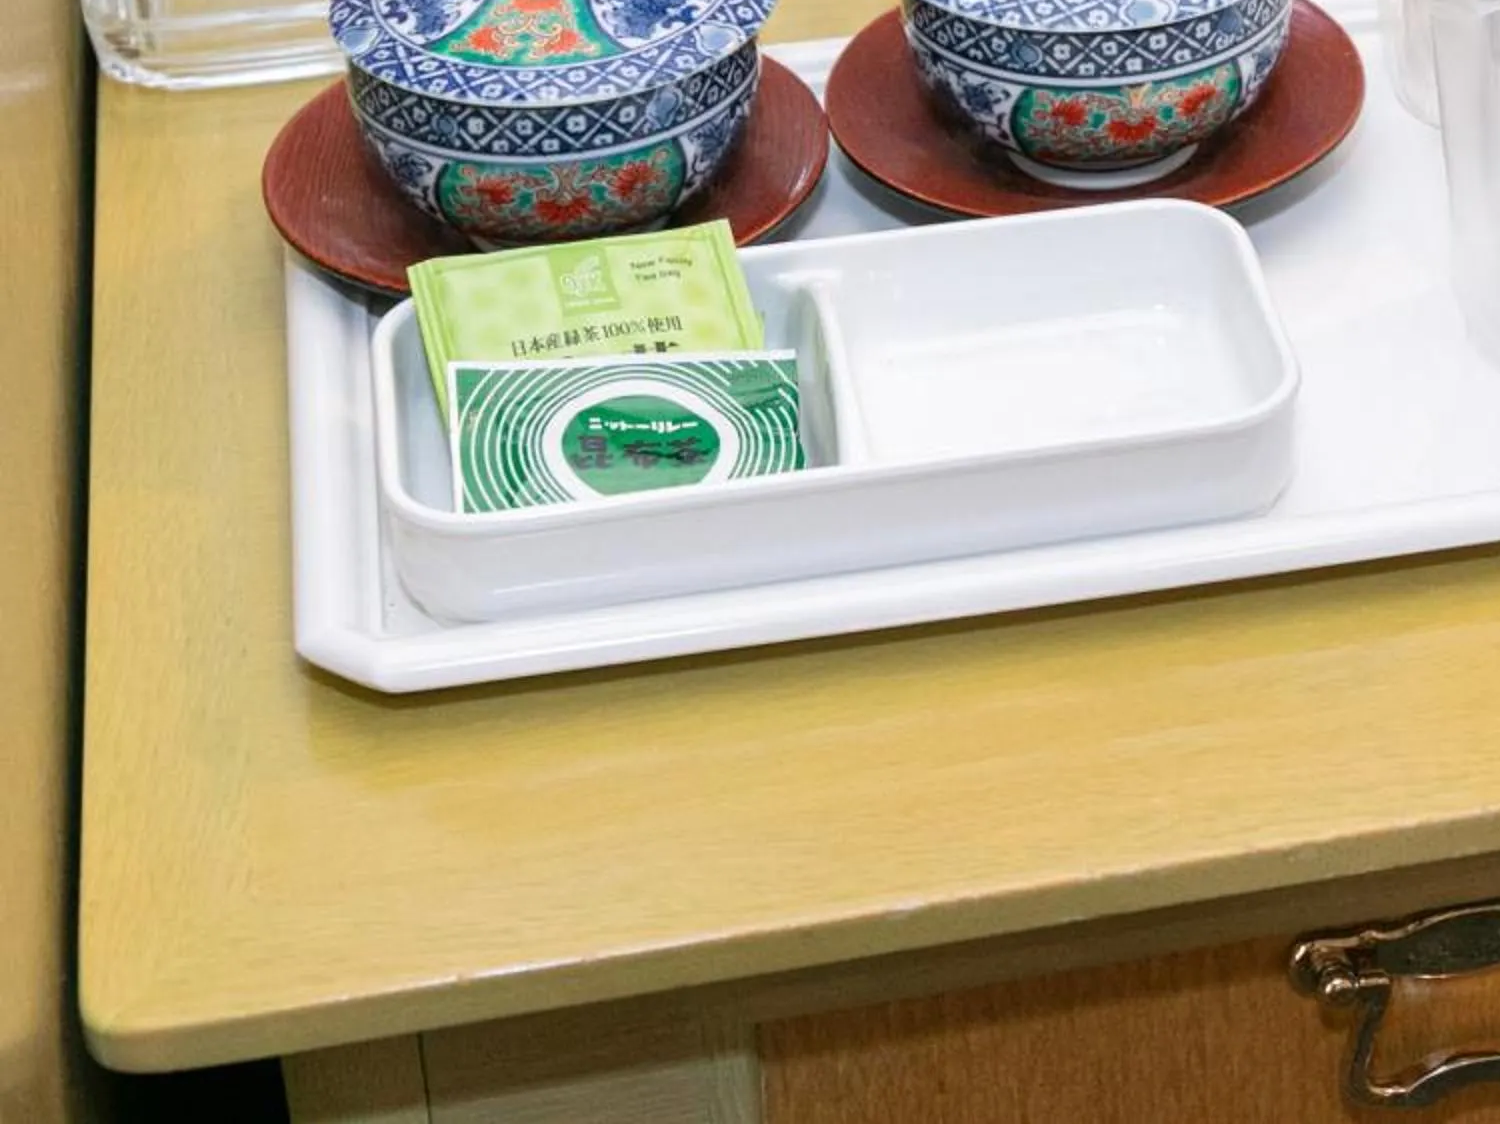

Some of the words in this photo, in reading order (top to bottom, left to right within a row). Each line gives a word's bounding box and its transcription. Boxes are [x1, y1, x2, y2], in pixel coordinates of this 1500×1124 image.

[511, 315, 684, 359] 日本産緑茶100%使用
